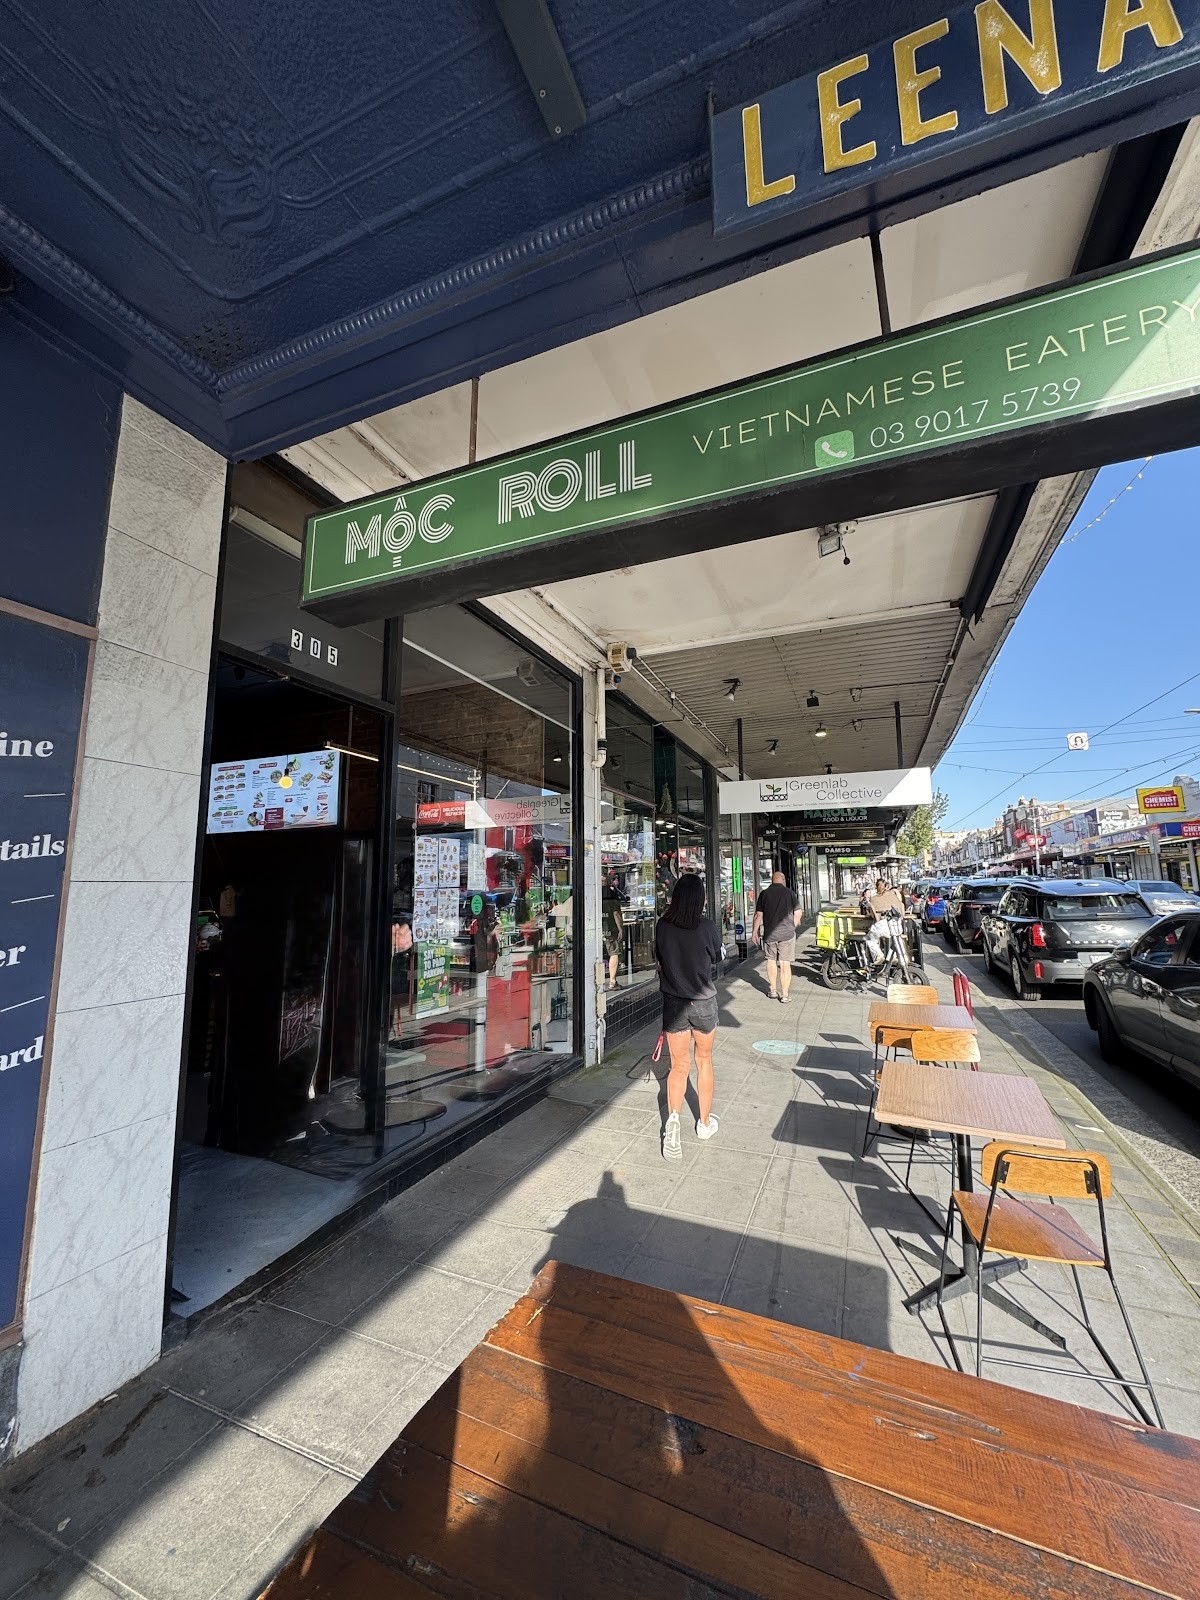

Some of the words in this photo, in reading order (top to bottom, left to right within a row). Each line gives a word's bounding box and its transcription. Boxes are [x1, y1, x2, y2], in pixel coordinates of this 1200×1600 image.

[741, 0, 1185, 208] LEENA
[692, 360, 966, 455] VIETNAMESE
[1005, 298, 1200, 372] EATERY
[869, 422, 905, 449] 03
[915, 399, 989, 438] 9017
[1002, 377, 1081, 416] 5739
[344, 496, 456, 568] MỘC
[497, 439, 652, 525] ROLL
[292, 630, 337, 664] 305
[789, 777, 848, 791] Greenlab
[816, 787, 882, 801] Collective
[1144, 796, 1177, 804] CHEMIST
[0, 834, 65, 861] tails
